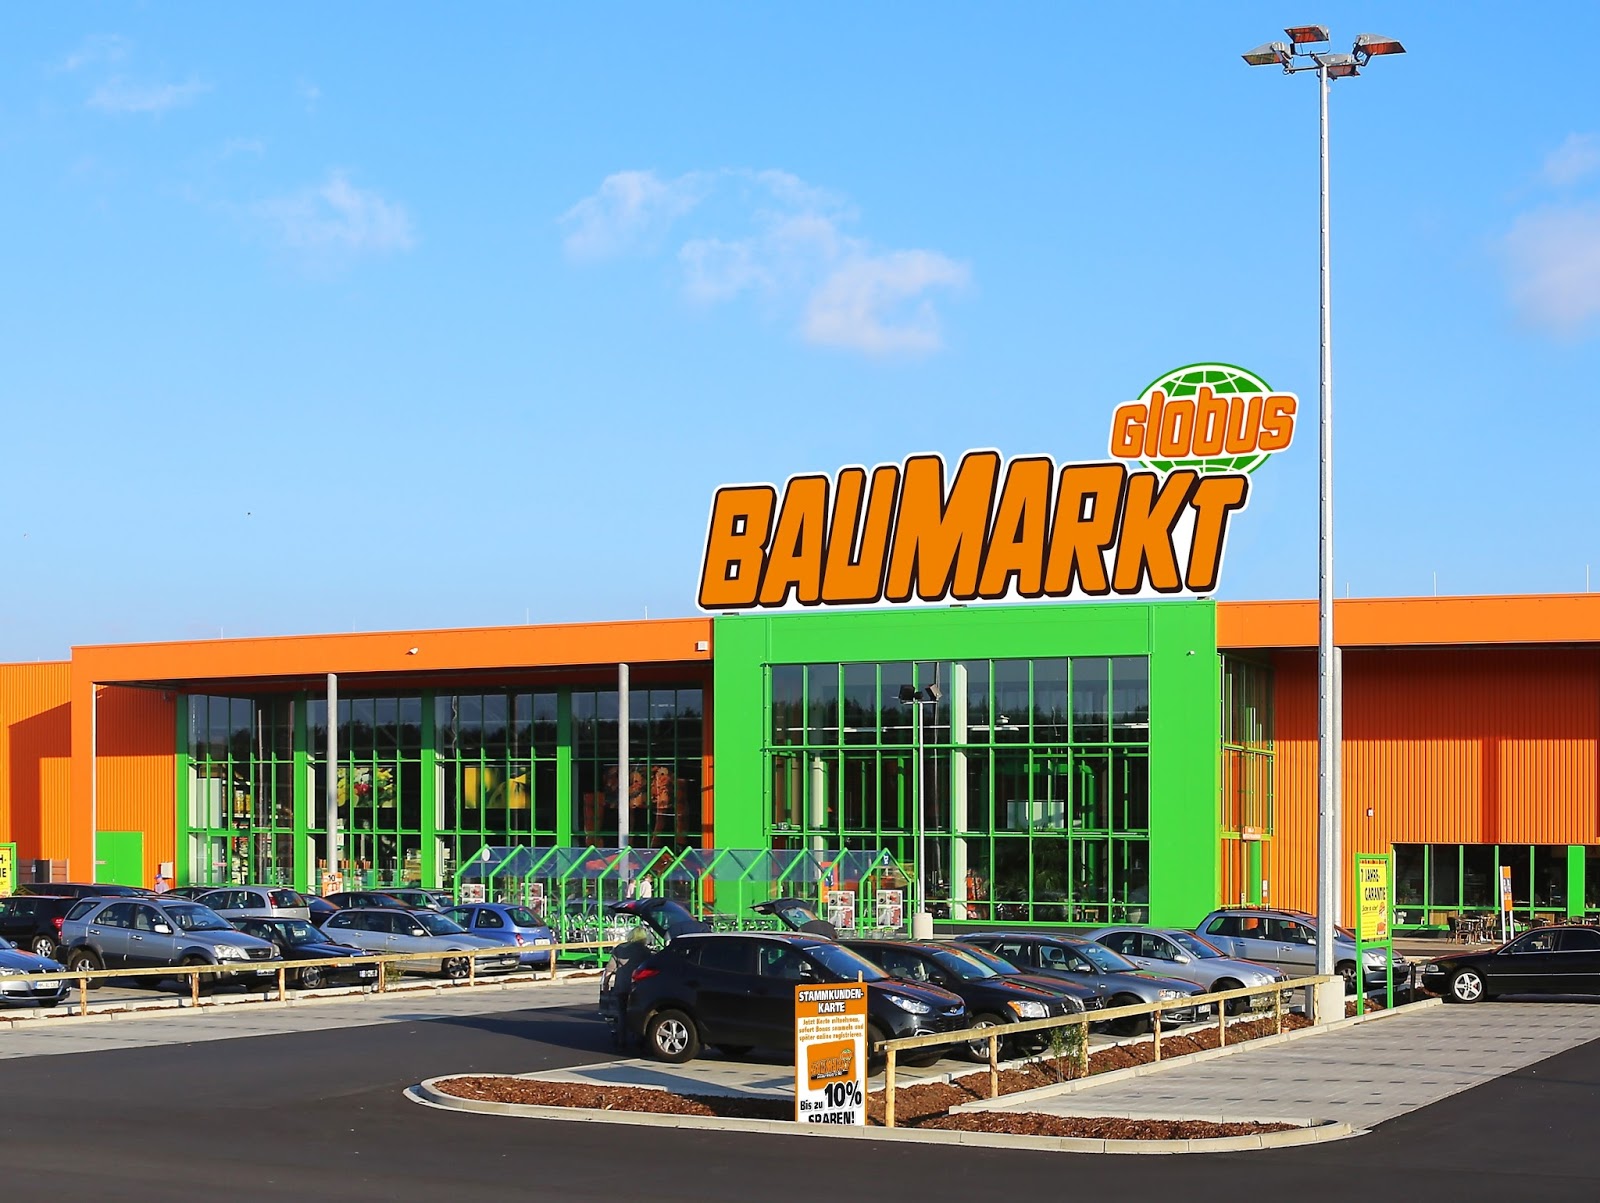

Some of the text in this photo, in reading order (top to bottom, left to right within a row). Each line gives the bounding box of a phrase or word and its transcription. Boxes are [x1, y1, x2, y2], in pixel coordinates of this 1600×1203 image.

[699, 450, 1248, 609] BAUMARKT
[1364, 886, 1386, 901] GARANTIE
[798, 988, 864, 1002] STAMMKUNDEN-
[818, 1001, 845, 1014] KARTE
[800, 1080, 862, 1110] Bis zu 10%
[808, 1111, 855, 1124] SPAREN!
